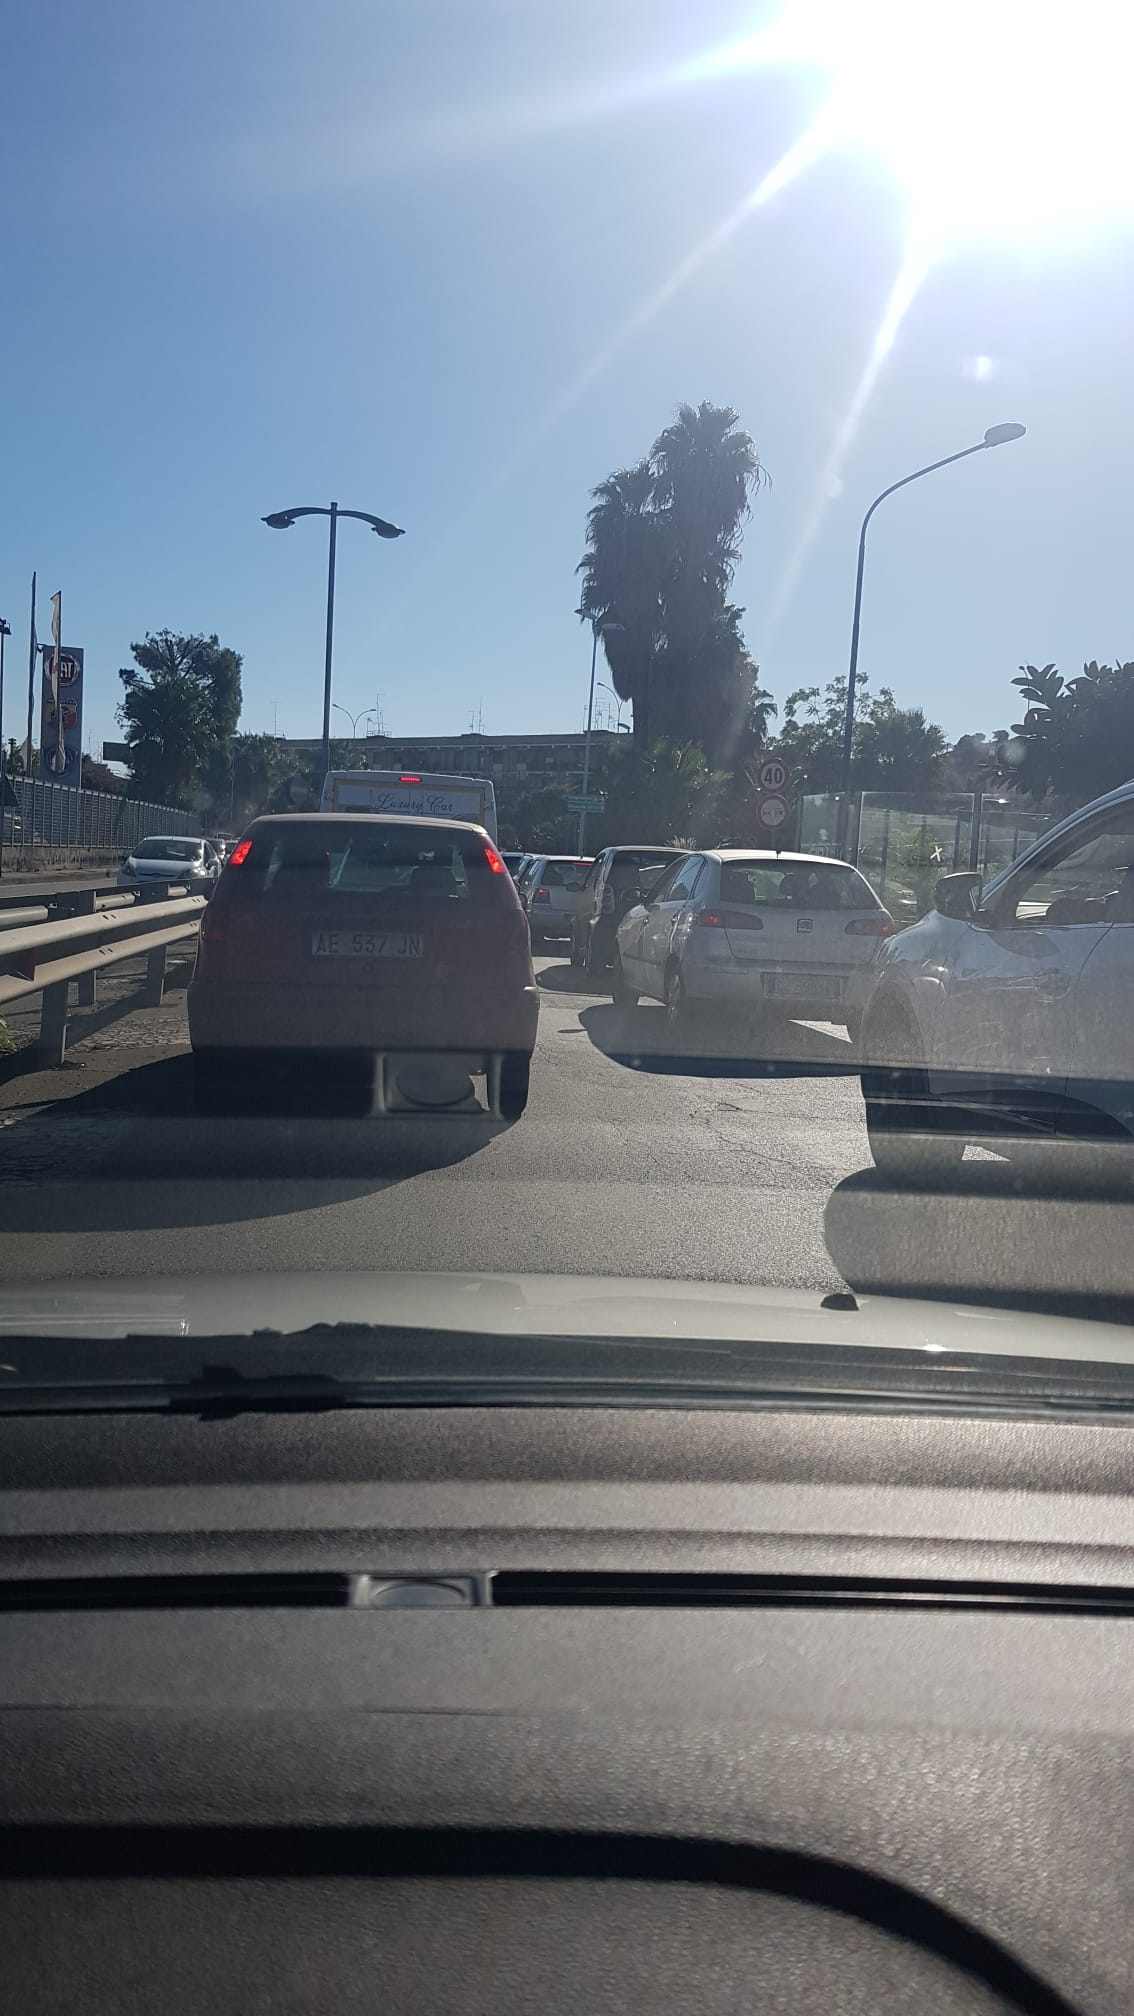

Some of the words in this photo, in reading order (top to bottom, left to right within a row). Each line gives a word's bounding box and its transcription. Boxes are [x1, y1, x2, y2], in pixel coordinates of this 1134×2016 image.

[764, 767, 783, 784] 40
[374, 793, 424, 814] Luxury
[427, 794, 454, 813] Car
[317, 933, 339, 953] AE
[352, 934, 388, 953] 537
[398, 935, 420, 954] JN
